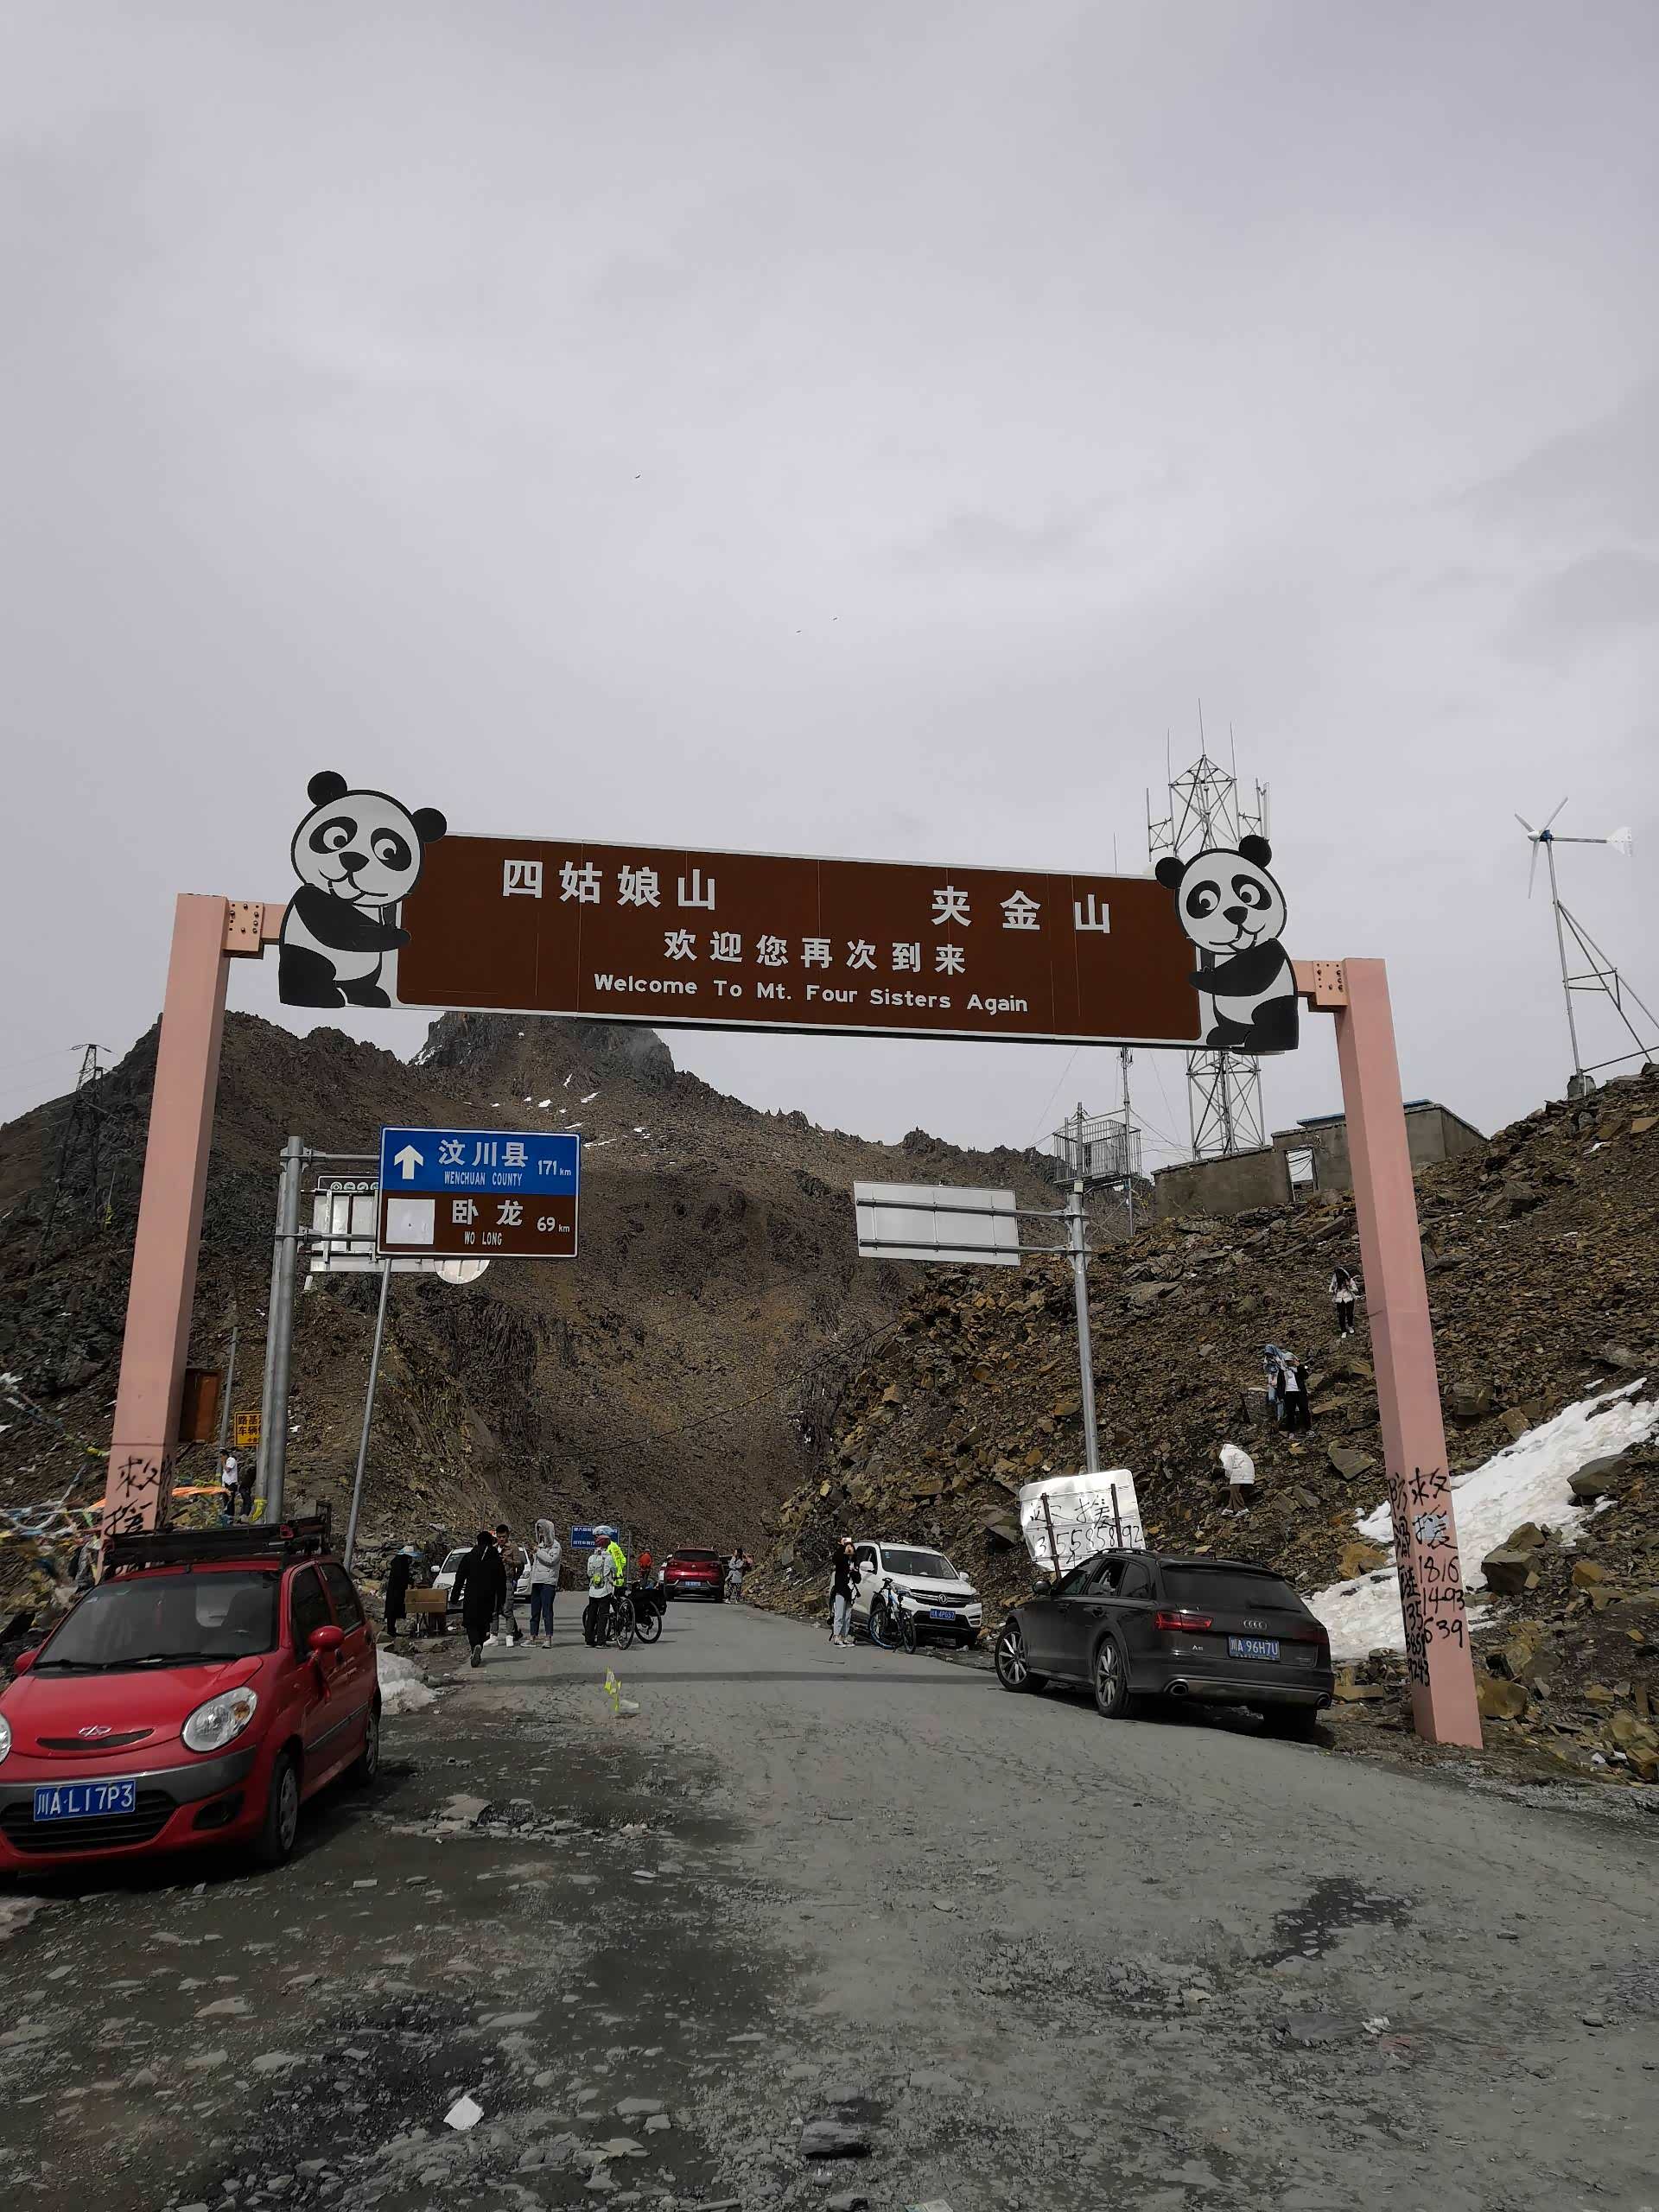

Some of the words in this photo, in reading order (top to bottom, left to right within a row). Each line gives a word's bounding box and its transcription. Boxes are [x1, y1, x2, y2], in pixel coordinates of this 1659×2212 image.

[502, 859, 715, 910] 四姑娘山
[931, 885, 1111, 934] 夹金山
[664, 928, 966, 976] 欢迎您再次到来
[594, 973, 697, 995] Welcome
[713, 979, 742, 997] To
[757, 982, 791, 1000] Mt.
[806, 985, 858, 1003] Four
[869, 988, 951, 1009] Sisters
[967, 994, 1028, 1015] Again
[438, 1139, 529, 1168] 汶川县
[537, 1160, 557, 1176] 171
[559, 1167, 572, 1176] km
[444, 1171, 486, 1185] WENCHUAN
[492, 1173, 523, 1186] COUNTY
[451, 1198, 524, 1227] 卧龙
[537, 1217, 556, 1232] 69
[558, 1224, 570, 1233] km
[464, 1231, 475, 1245] WO
[481, 1231, 503, 1246] LONG
[238, 1425, 261, 1436] 车辆
[1419, 1555, 1459, 1584] 1816
[1423, 1586, 1465, 1616] 1493
[1424, 1618, 1463, 1649] 639
